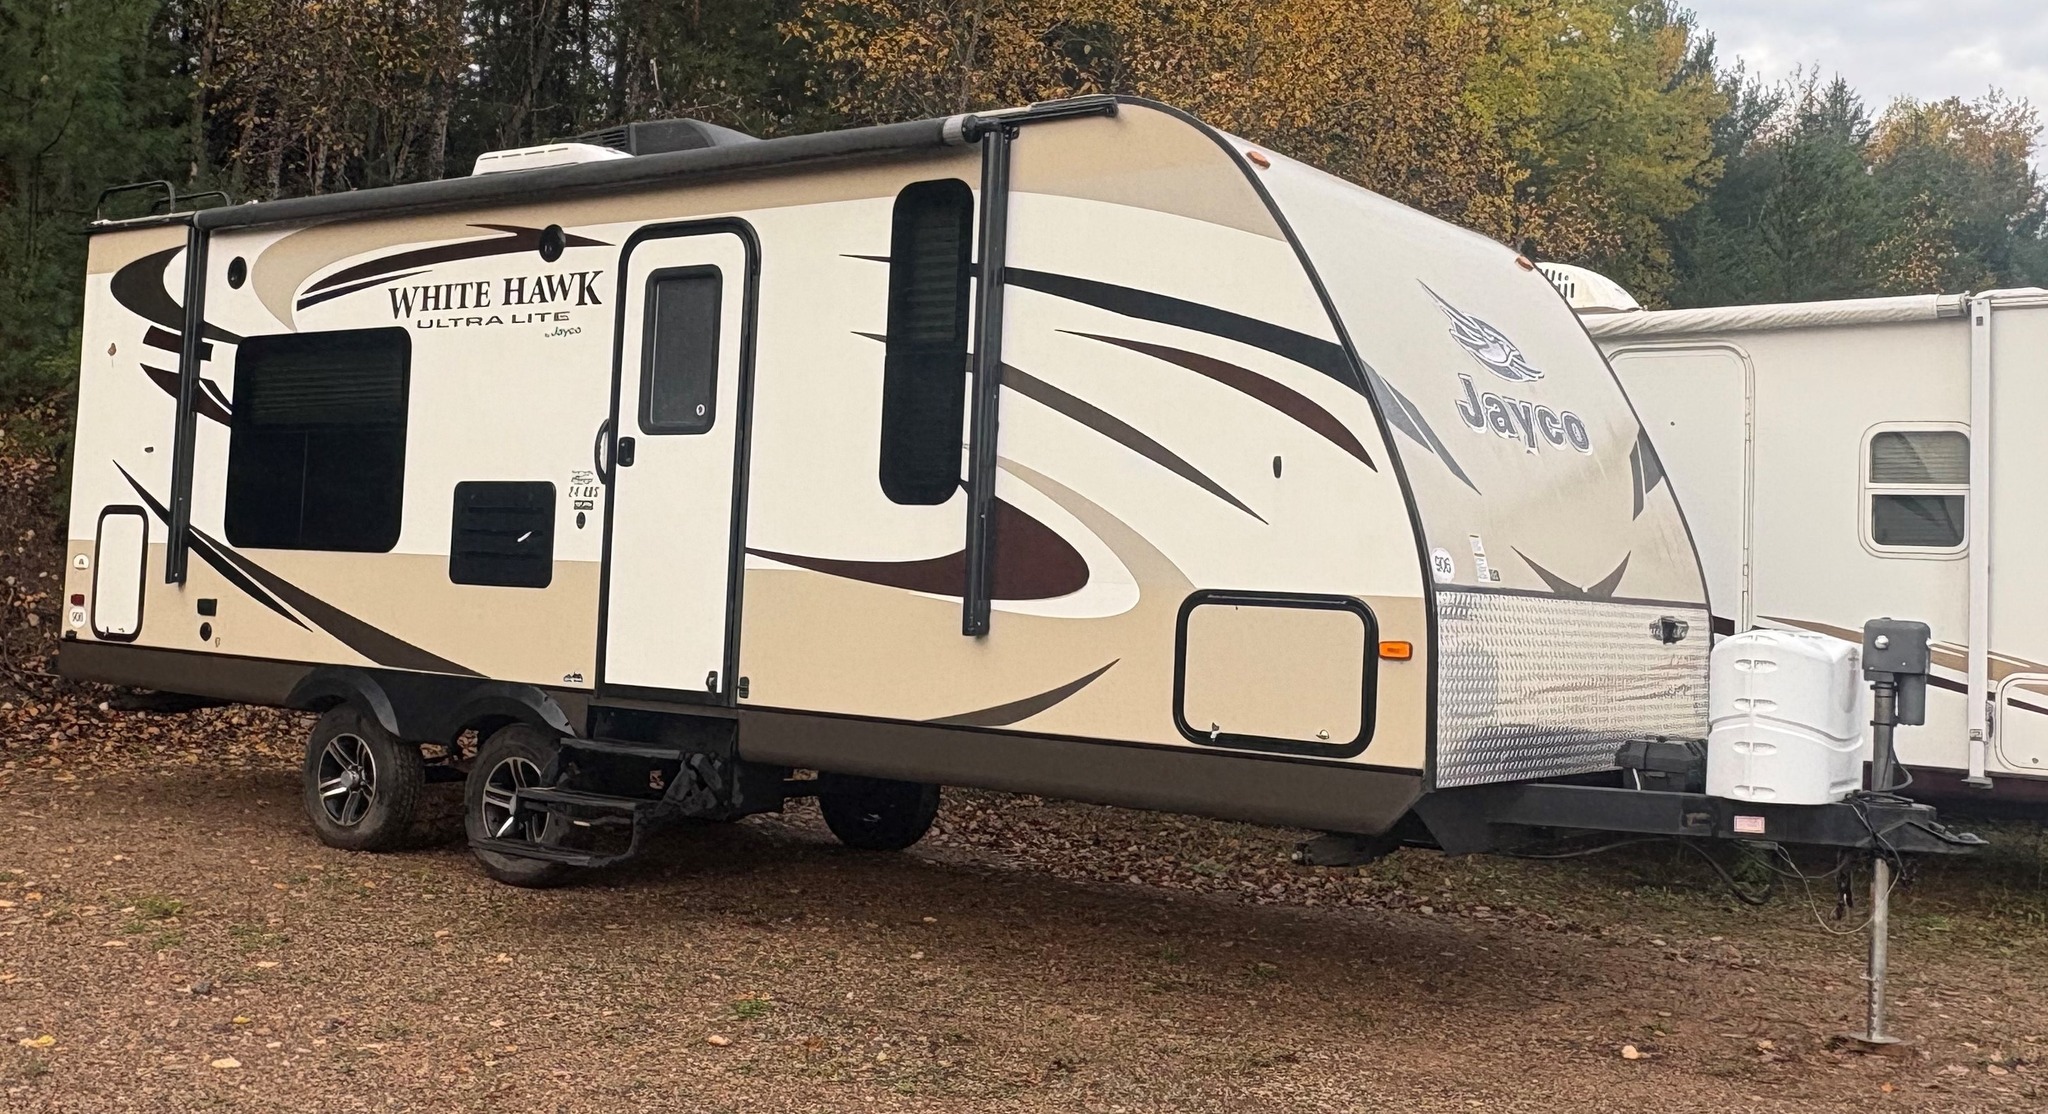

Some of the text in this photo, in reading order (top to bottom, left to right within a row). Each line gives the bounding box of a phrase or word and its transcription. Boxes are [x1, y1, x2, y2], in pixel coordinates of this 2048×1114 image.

[388, 270, 604, 319] WHITE HAWK
[416, 311, 571, 329] ULTRA LITE
[1454, 372, 1593, 456] Jayco
